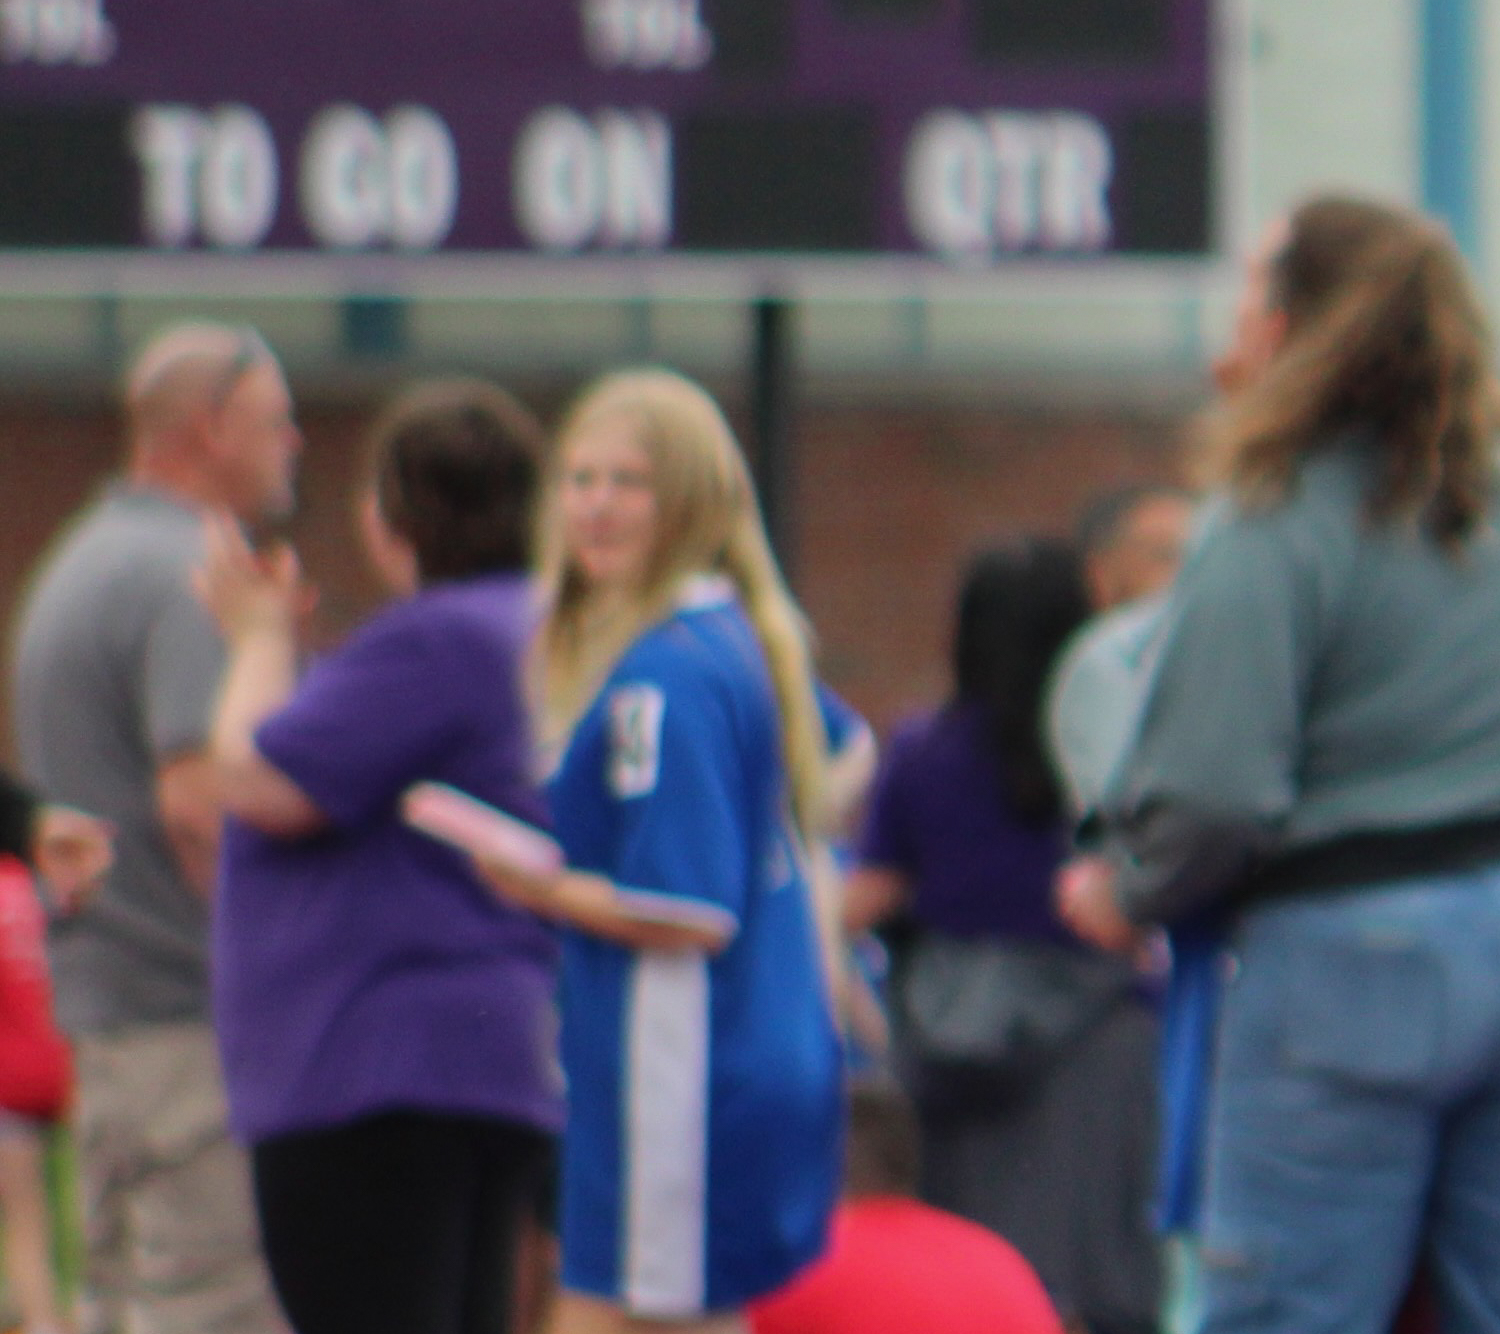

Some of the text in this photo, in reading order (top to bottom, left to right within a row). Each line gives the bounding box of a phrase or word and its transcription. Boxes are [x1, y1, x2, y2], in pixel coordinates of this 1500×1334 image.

[136, 104, 458, 253] TO GO
[514, 105, 674, 253] ON
[904, 107, 1113, 265] QTR
